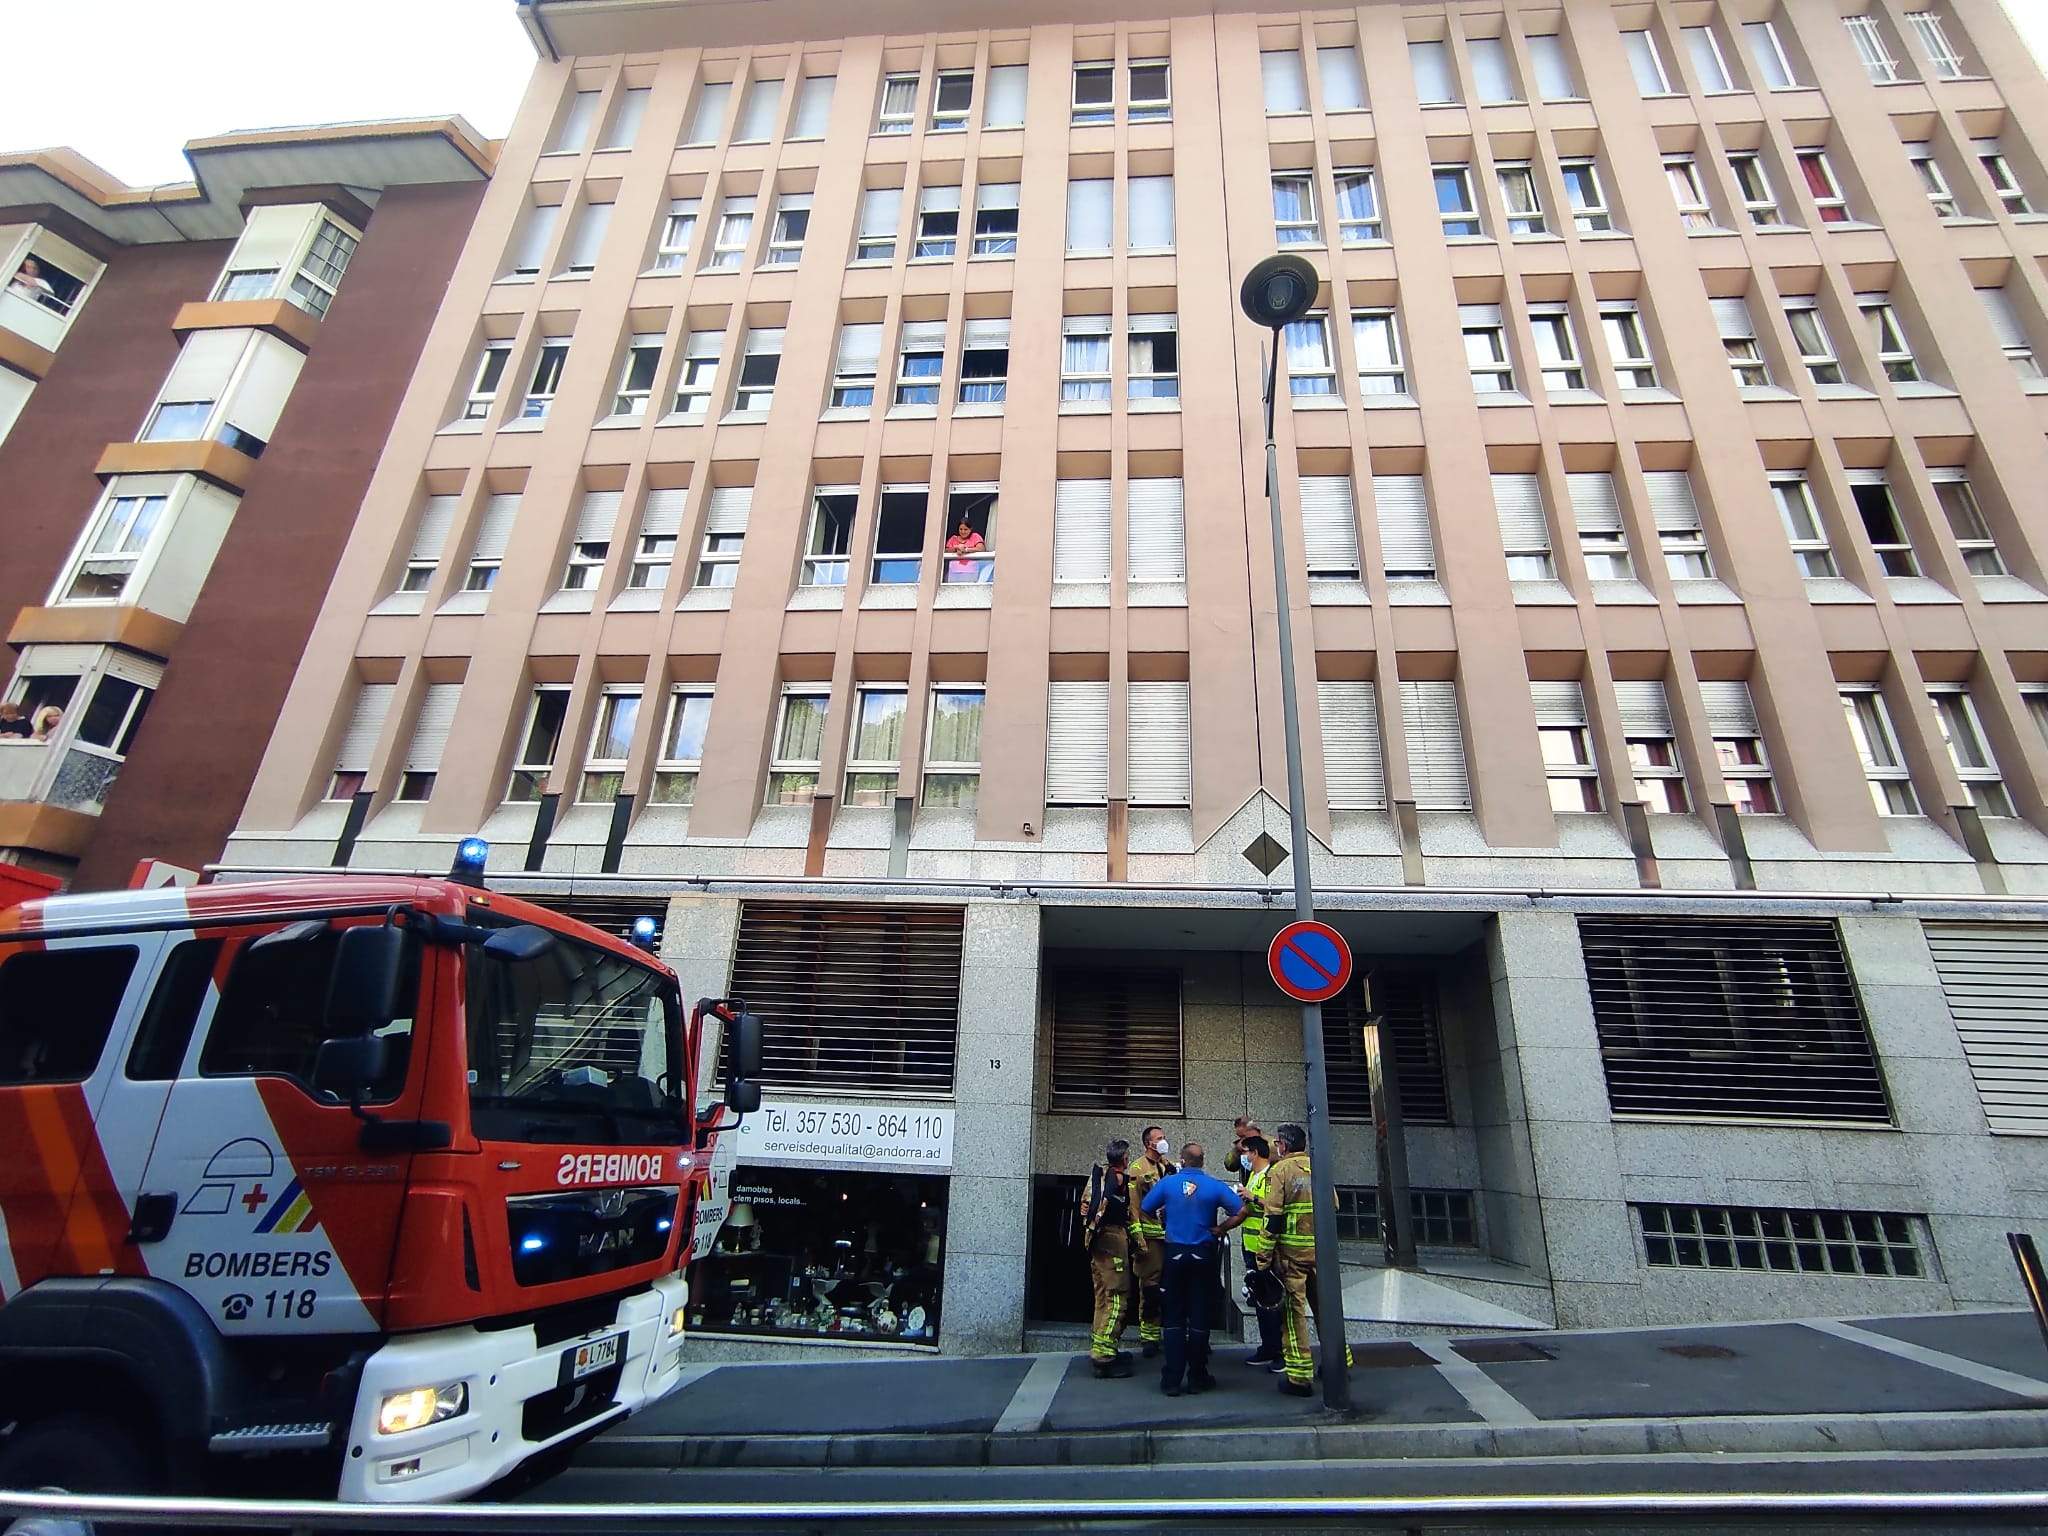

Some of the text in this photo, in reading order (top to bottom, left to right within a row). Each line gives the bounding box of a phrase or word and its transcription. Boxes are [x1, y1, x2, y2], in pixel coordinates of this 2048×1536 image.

[990, 1059, 1001, 1069] 13
[765, 1109, 790, 1132] Tel.
[796, 1110, 827, 1134] 357
[831, 1112, 861, 1135] 530
[877, 1114, 908, 1137] 864
[914, 1116, 942, 1139] 110
[764, 1140, 941, 1159] serveisdequalitat@andorra.ad
[184, 1251, 332, 1278] BOMBERS
[265, 1289, 317, 1319] 118
